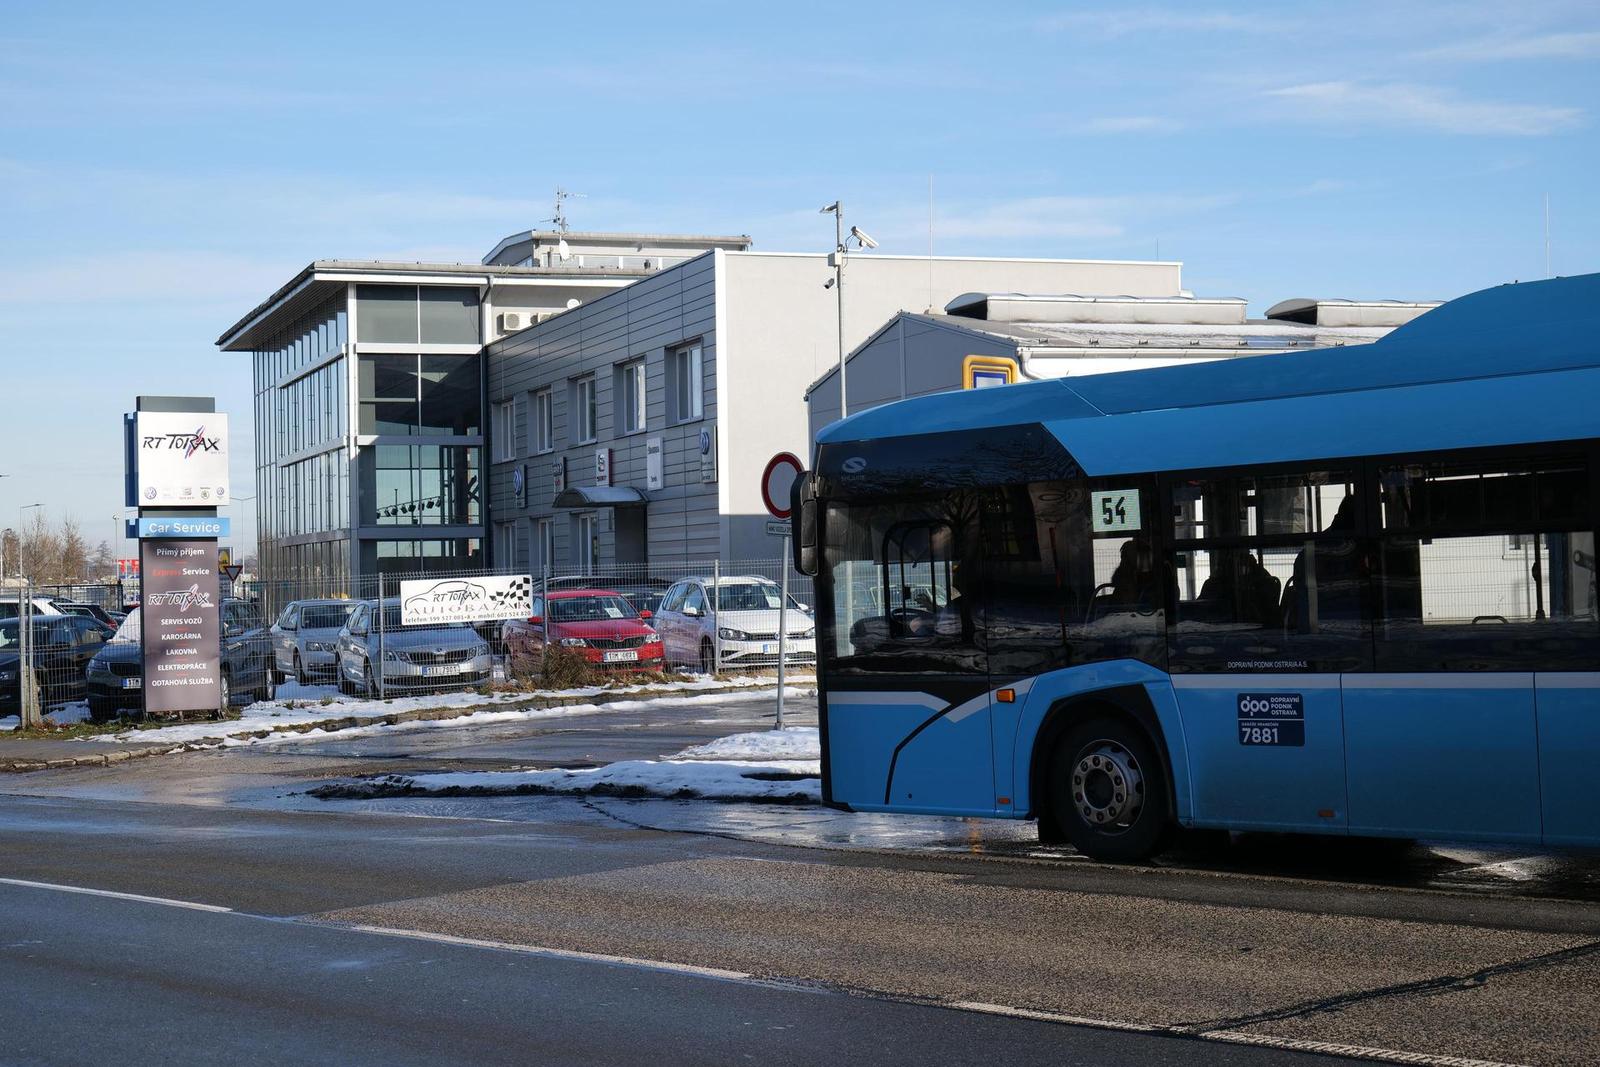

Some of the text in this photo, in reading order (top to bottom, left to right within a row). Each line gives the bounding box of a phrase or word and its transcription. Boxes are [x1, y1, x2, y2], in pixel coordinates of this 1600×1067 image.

[143, 429, 219, 453] RT TORAX
[1102, 496, 1125, 525] 54
[149, 522, 220, 533] Car Service
[156, 547, 205, 557] Přímý příjem
[182, 567, 210, 577] Service
[148, 593, 167, 606] RT
[433, 592, 448, 603] RT
[161, 616, 203, 626] SERVIS VOZŮ
[161, 632, 202, 641] KAROSÁRNA
[166, 648, 198, 656] LAKOVNA
[157, 662, 207, 671] ELEKTROPRÁCE
[151, 676, 214, 687] ODTAHOVÁ SLUŽBA
[1241, 728, 1279, 743] 7881
